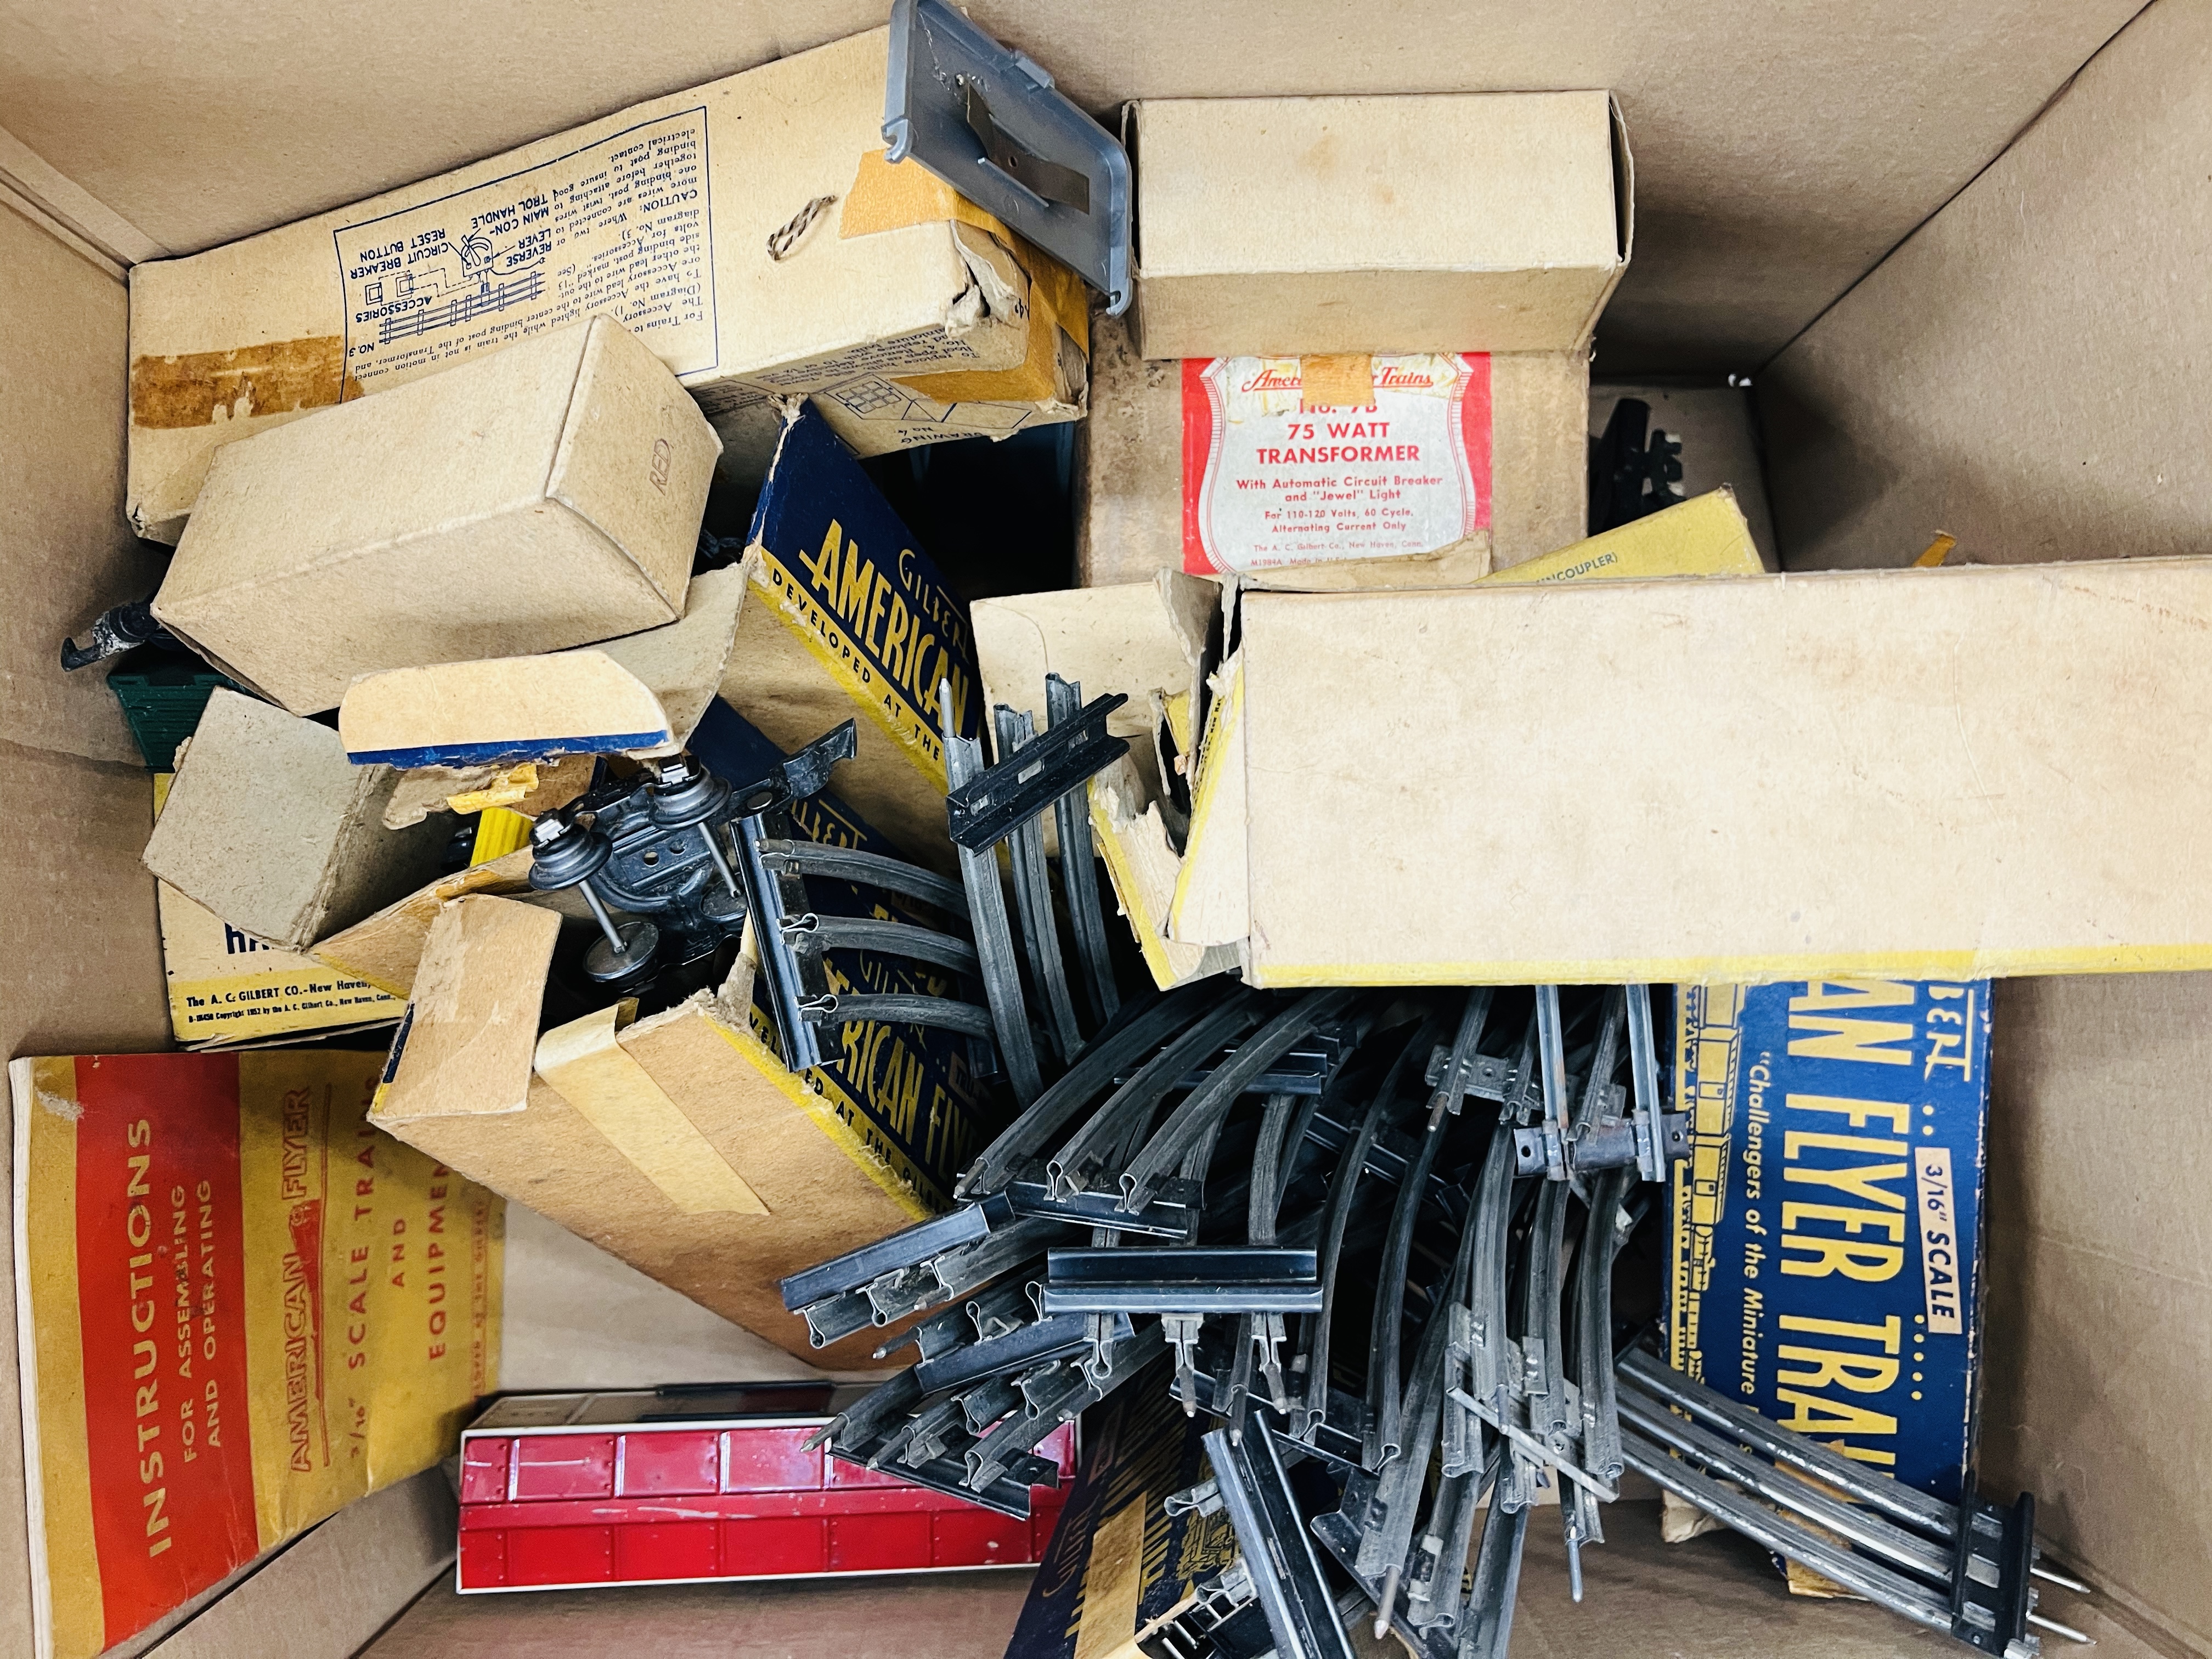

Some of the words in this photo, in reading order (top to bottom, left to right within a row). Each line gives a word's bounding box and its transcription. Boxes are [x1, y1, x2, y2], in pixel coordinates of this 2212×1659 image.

[648, 128, 695, 151] electrical
[608, 143, 644, 163] contact.
[657, 140, 696, 156] binding
[630, 151, 650, 167] post
[653, 153, 696, 170] together
[613, 164, 623, 172] to
[616, 167, 646, 183] before
[678, 165, 697, 174] one
[580, 171, 607, 187] insure
[634, 171, 672, 189] binding
[670, 177, 697, 189] more
[552, 183, 574, 202] good
[569, 182, 610, 204] attaching
[638, 187, 664, 199] wires
[639, 188, 698, 213] CAUTION:
[518, 194, 548, 211] TROL
[554, 202, 563, 210] to
[583, 198, 603, 212] twist
[618, 197, 632, 207] are
[471, 205, 516, 229] HANDLE
[523, 206, 549, 225] MAIN
[555, 208, 578, 223] wires
[568, 206, 612, 232] connected
[599, 212, 627, 228] Where
[657, 209, 699, 225] diagram
[489, 218, 519, 236] CON-
[574, 227, 590, 239] two
[636, 221, 652, 233] No.
[651, 229, 666, 239] for
[674, 221, 699, 233] volts
[410, 228, 445, 249] RESET
[518, 228, 551, 250] LEVER
[556, 238, 566, 246] or
[680, 232, 699, 244] side
[360, 241, 404, 263] BUTTON
[407, 241, 449, 265] CIRCUIT
[506, 241, 552, 268] REVERSE
[637, 239, 675, 255] binding
[684, 244, 700, 254] the
[652, 250, 679, 262] other
[682, 257, 701, 266] ore
[350, 257, 402, 280] BREAKER
[557, 263, 575, 276] (See
[577, 261, 611, 283] marked
[606, 267, 625, 279] wire
[628, 262, 677, 283] Accessory
[629, 258, 648, 274] lead
[686, 268, 699, 279] To
[578, 281, 591, 291] the
[635, 281, 649, 292] the
[656, 273, 680, 284] have
[558, 288, 575, 298] out-
[584, 288, 603, 300] wire
[606, 279, 624, 295] lead
[650, 283, 701, 301] (Diagram
[556, 301, 569, 312] the
[585, 288, 629, 311] Accessory
[630, 297, 645, 309] No.
[682, 296, 703, 307] The
[356, 295, 432, 323] ACCESSORIES
[526, 308, 553, 322] center
[623, 302, 673, 323] Accessory
[684, 311, 703, 321] For
[551, 308, 580, 328] lighted
[647, 316, 681, 329] Trains
[468, 328, 487, 341] post
[489, 319, 523, 334] binding
[523, 322, 546, 336] while
[455, 337, 464, 347] of
[477, 337, 498, 347] train
[504, 331, 518, 341] the
[349, 347, 356, 358] 3
[358, 342, 375, 354] NO.
[438, 341, 452, 351] the
[445, 348, 459, 358] not
[464, 345, 471, 353] is
[355, 362, 372, 374] and
[394, 358, 426, 370] motion
[353, 368, 389, 382] connect
[1381, 367, 1434, 388] Trains
[1288, 424, 1314, 439] 75
[1327, 422, 1390, 438] WATT
[1256, 445, 1420, 464] TRANSFORMER
[650, 438, 672, 496] RED
[1235, 479, 1266, 489] With
[1272, 478, 1337, 489] Automatic
[1344, 476, 1387, 487] Circuit
[1394, 476, 1443, 486] Breaker
[1285, 492, 1307, 502] and
[1313, 489, 1364, 500] "Jewel"
[1369, 489, 1402, 501] Light
[1286, 510, 1326, 519] 110-120
[1364, 509, 1376, 517] 60
[1272, 524, 1330, 533] Alternating
[1336, 522, 1377, 531] Current
[1383, 521, 1407, 531] Only
[899, 549, 970, 665] GILBERT
[799, 518, 969, 737] AMERICAN
[772, 568, 871, 684] DEVELOPED
[884, 694, 901, 718] AT
[915, 724, 940, 761] THE
[186, 996, 205, 1007] The
[211, 994, 222, 1005] A.
[239, 988, 280, 1001] GILBERT
[836, 1101, 854, 1127] AT
[1743, 1052, 1771, 1200] "Challengers
[281, 1085, 310, 1201] FLYER
[1781, 1094, 1910, 1282] FLYER
[1921, 1164, 1949, 1222] 3/16"
[1745, 1209, 1768, 1237] of
[391, 1217, 407, 1288] AND
[428, 1163, 450, 1361] EQUIPMEN
[1745, 1243, 1767, 1279] the
[195, 1179, 218, 1362] OPERATING
[1926, 1229, 1955, 1319] SCALE
[171, 1184, 194, 1379] ASSEMBLING
[348, 1245, 369, 1370] SCALE
[127, 1118, 173, 1559] INSTRUCTIONS
[1741, 1288, 1764, 1395] Miniature
[283, 1251, 312, 1473] AMERICAN
[1777, 1314, 1901, 1478] TRA
[204, 1379, 223, 1448] AND
[180, 1397, 197, 1463] FOR
